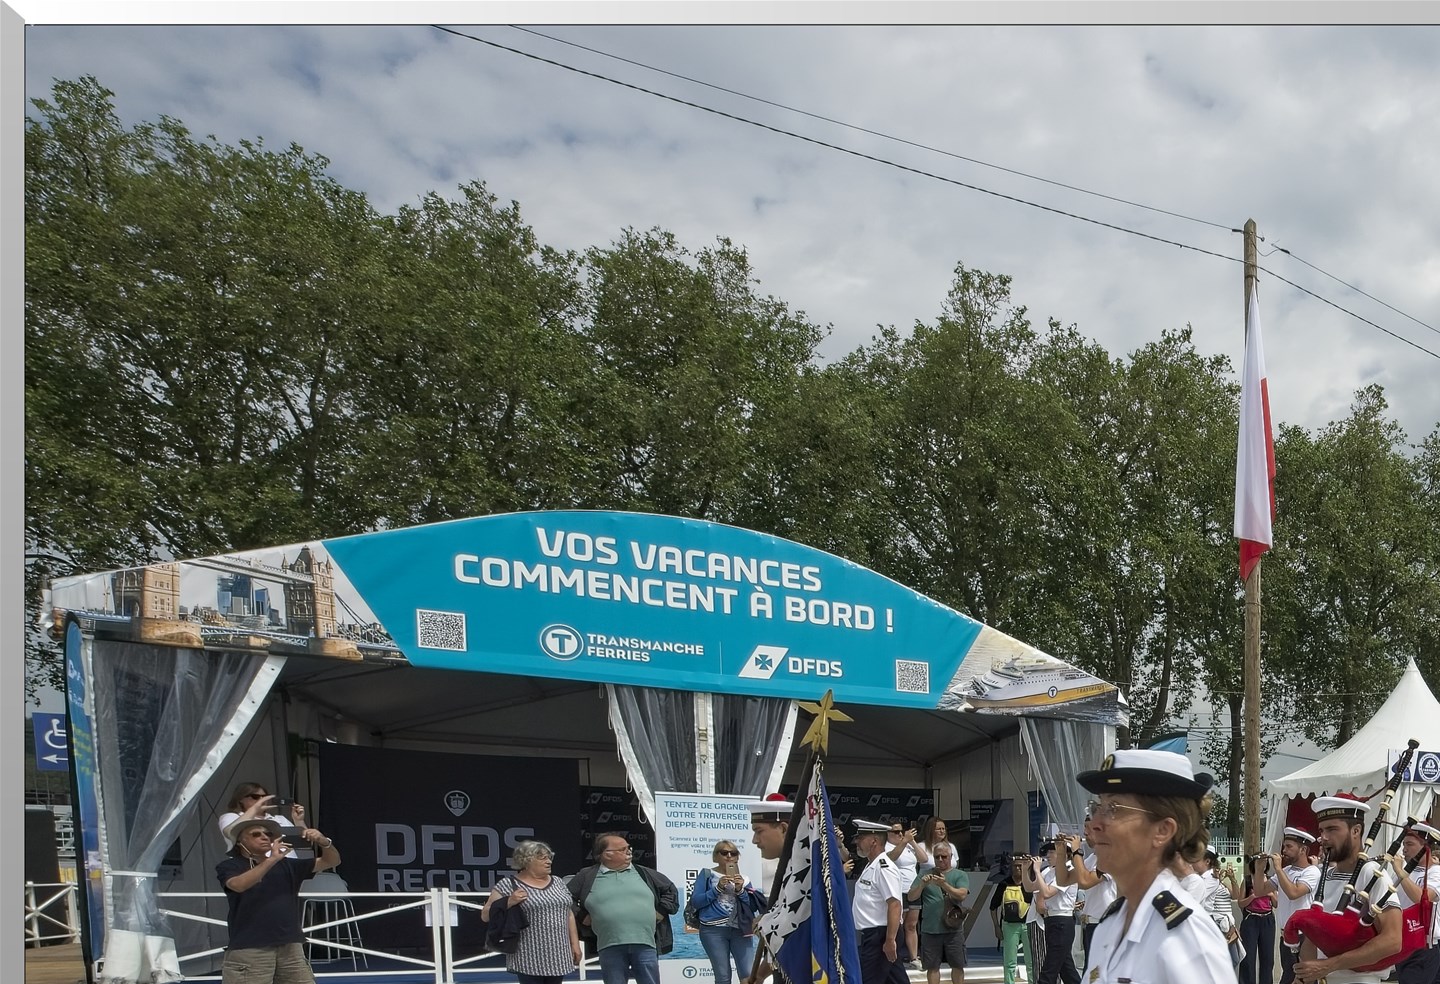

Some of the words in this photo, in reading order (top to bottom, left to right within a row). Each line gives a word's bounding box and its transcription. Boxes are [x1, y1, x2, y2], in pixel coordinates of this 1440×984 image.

[535, 527, 619, 565] VOS
[630, 541, 822, 592] VACANCES
[454, 553, 738, 616] COMMENCENT
[750, 585, 774, 620] À
[785, 597, 876, 632] BORD
[886, 608, 895, 634] !
[587, 633, 705, 656] TRANSMANCHE
[587, 646, 651, 662] FERRIES
[788, 656, 843, 678] DFDS
[664, 801, 698, 809] TENTEZ
[666, 811, 696, 819] VOTRE
[698, 812, 748, 820] TRAVERSÉE
[665, 821, 749, 830] DIEPPE-NEWHAVEN
[375, 823, 535, 867] DFDS
